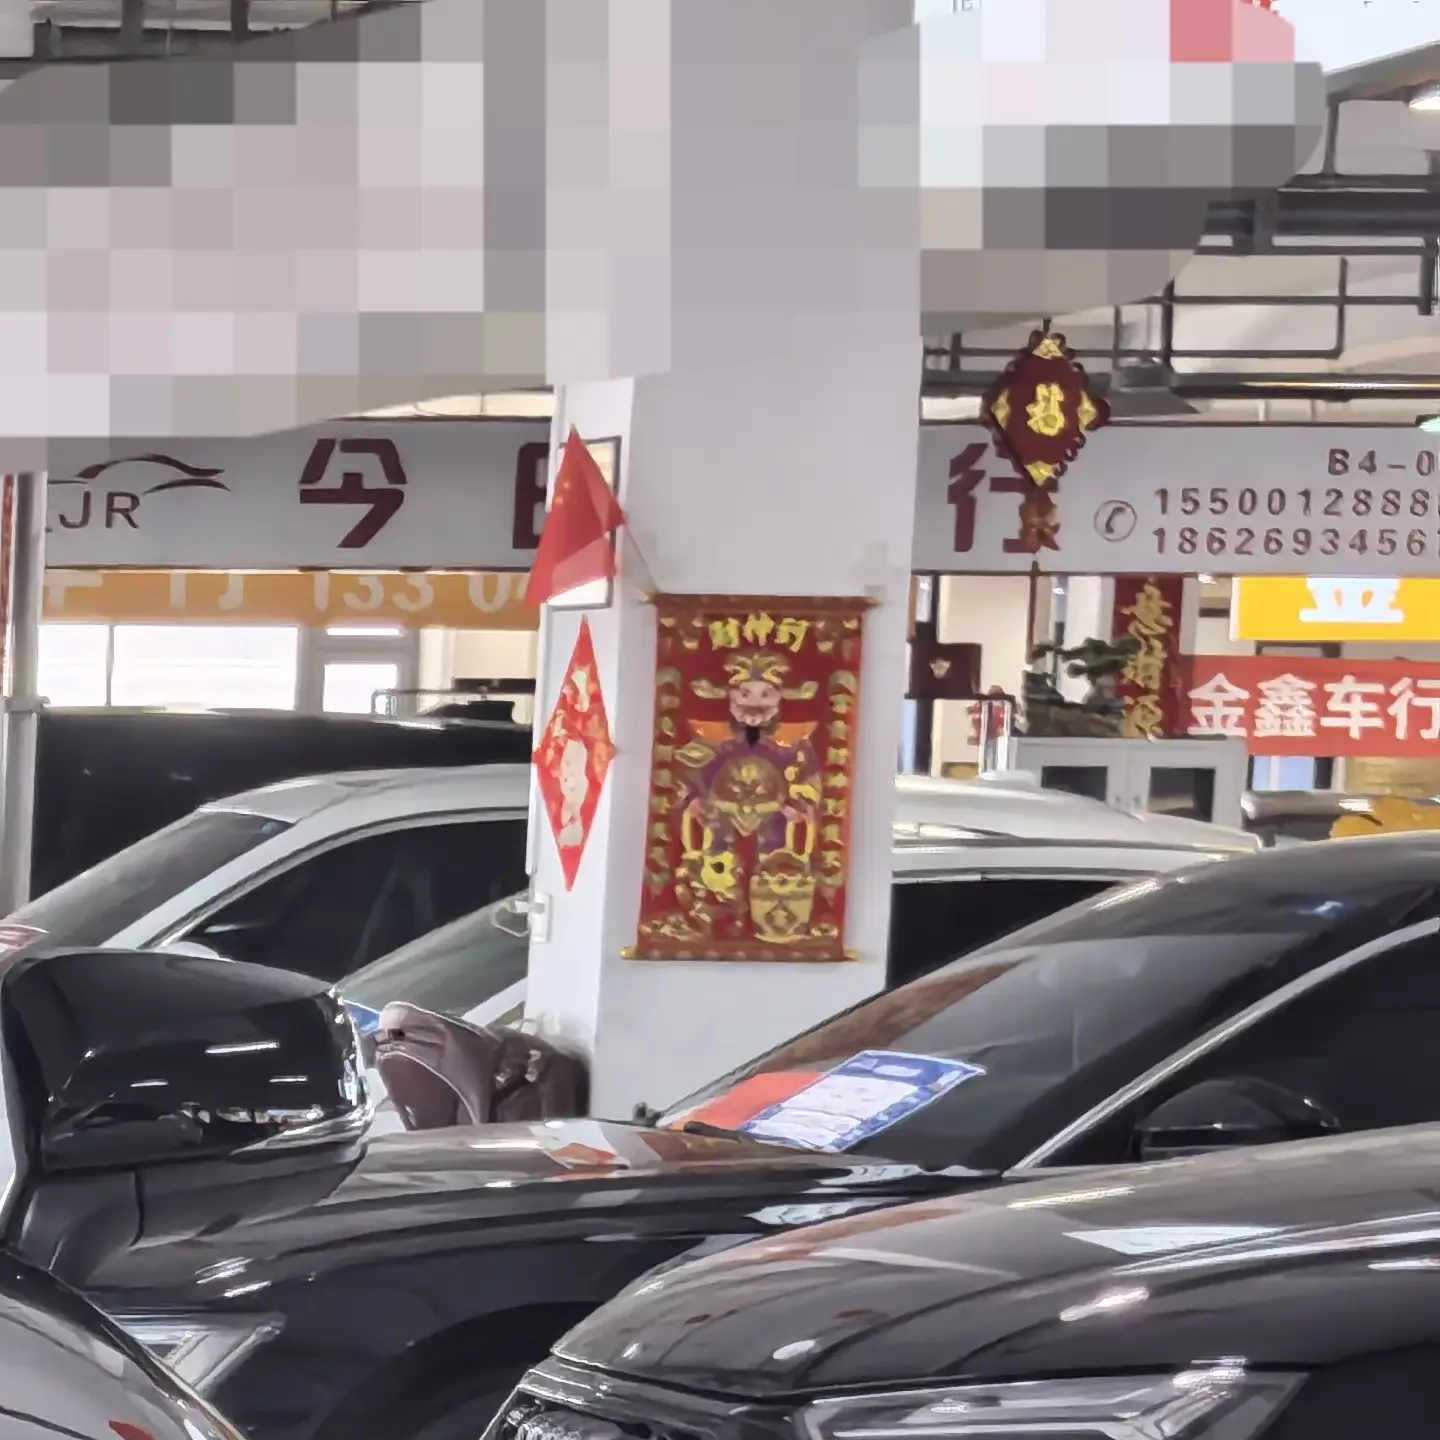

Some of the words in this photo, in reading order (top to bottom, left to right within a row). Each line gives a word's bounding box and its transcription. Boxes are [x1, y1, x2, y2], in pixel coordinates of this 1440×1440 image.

[1327, 448, 1440, 476] B4-0
[1153, 487, 1440, 518] 1550012888
[1152, 527, 1440, 558] 1862693456
[1187, 673, 1440, 740] 金鑫车行
